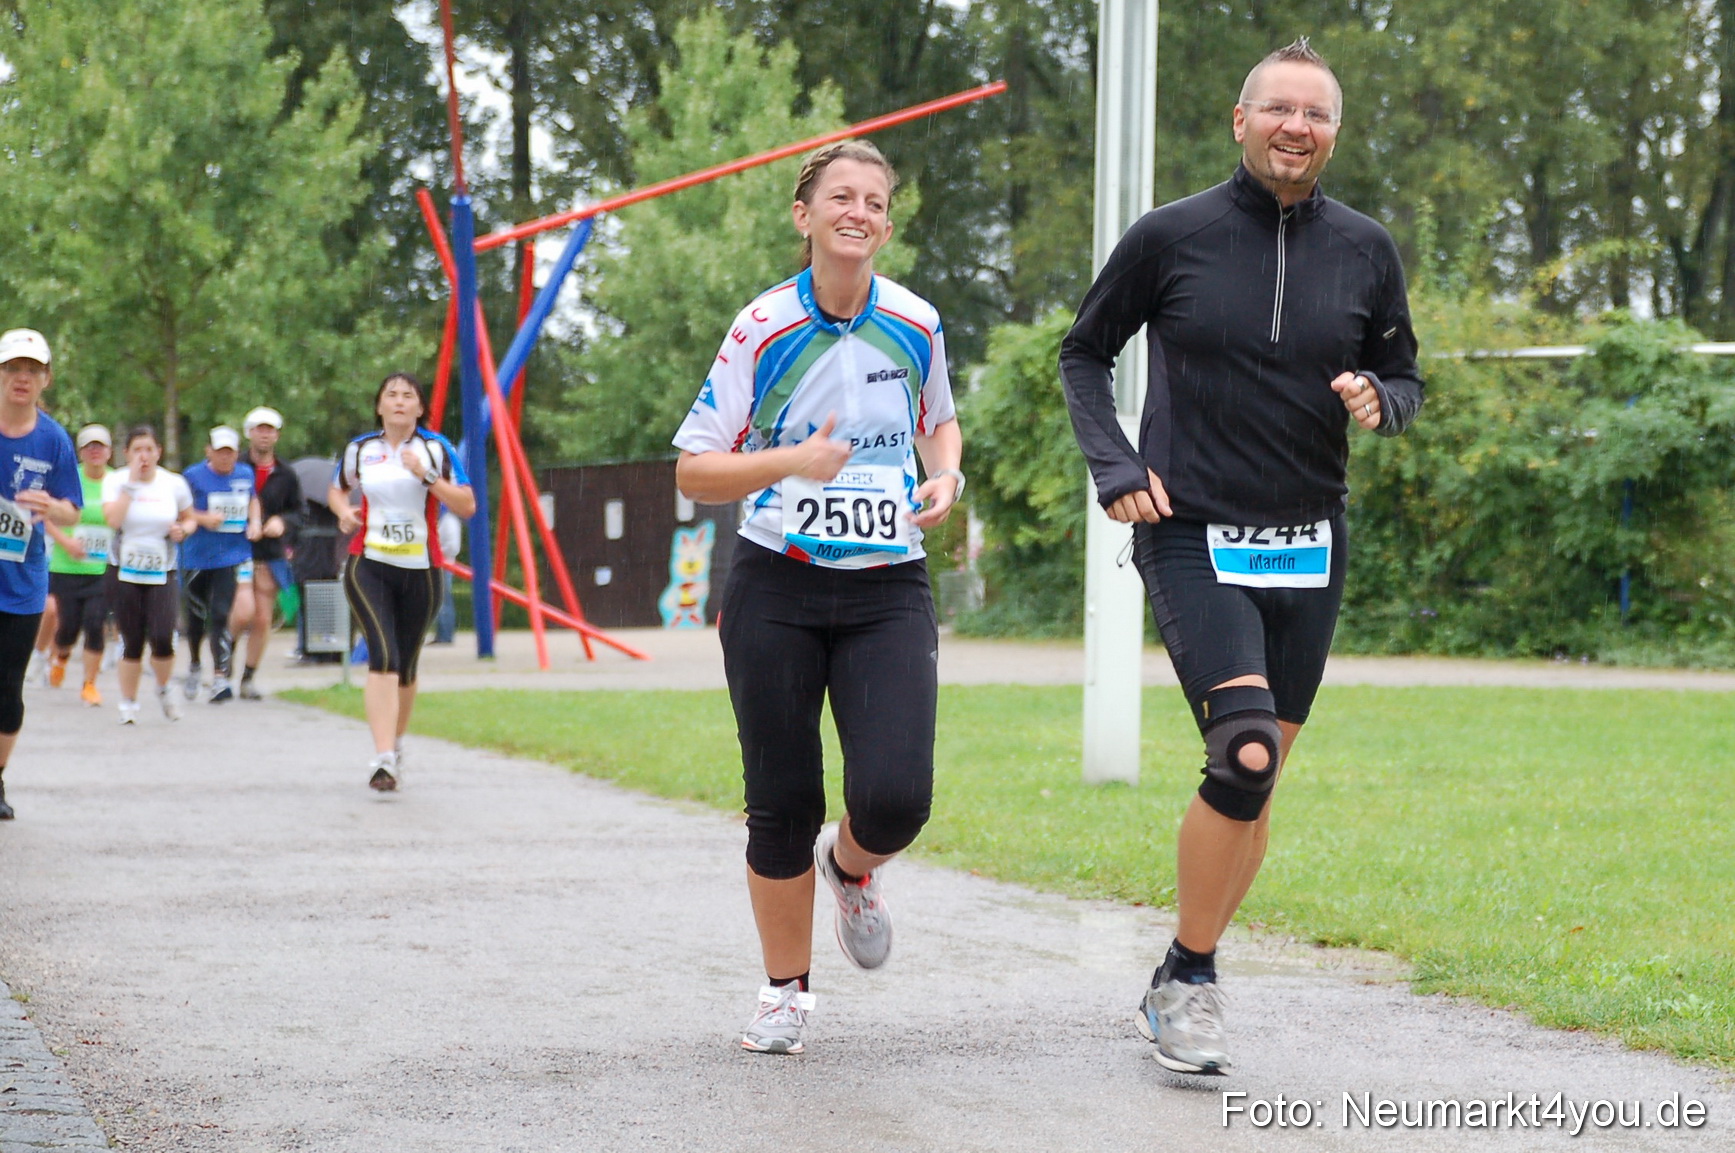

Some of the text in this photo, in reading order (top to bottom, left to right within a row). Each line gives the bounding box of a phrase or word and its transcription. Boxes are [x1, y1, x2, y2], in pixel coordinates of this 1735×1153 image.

[796, 497, 898, 540] 2509
[382, 524, 415, 543] 456
[1249, 553, 1296, 570] Martin
